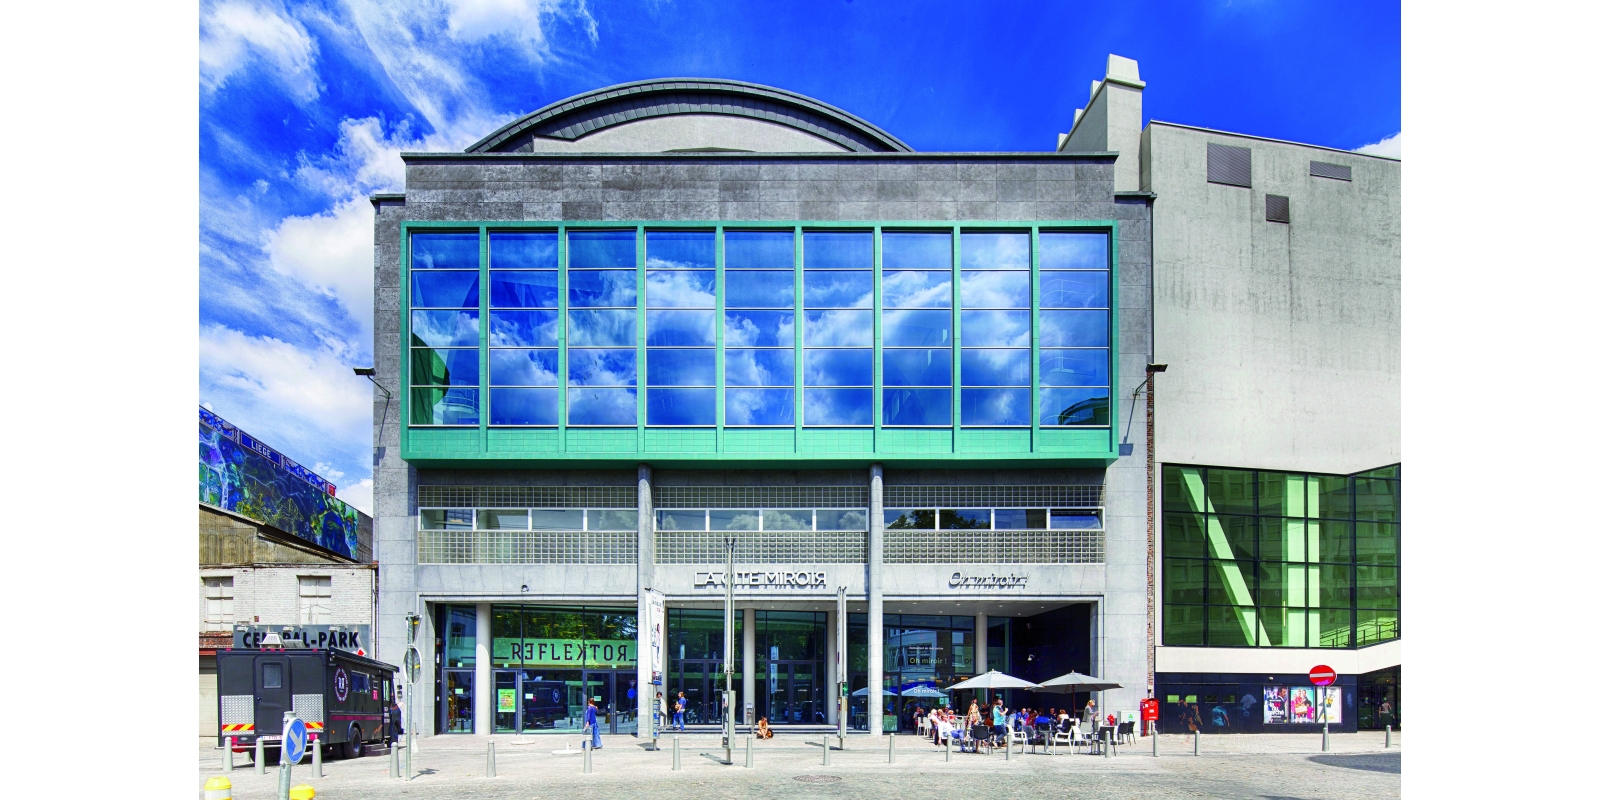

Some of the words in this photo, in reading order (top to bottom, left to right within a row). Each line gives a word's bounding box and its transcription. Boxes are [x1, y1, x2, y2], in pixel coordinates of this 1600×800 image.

[251, 440, 271, 459] LIEGE
[694, 571, 716, 585] LA
[765, 571, 827, 585] MIROIR
[243, 631, 359, 648] CERAL-PARK
[511, 642, 628, 662] REFLEKTOR
